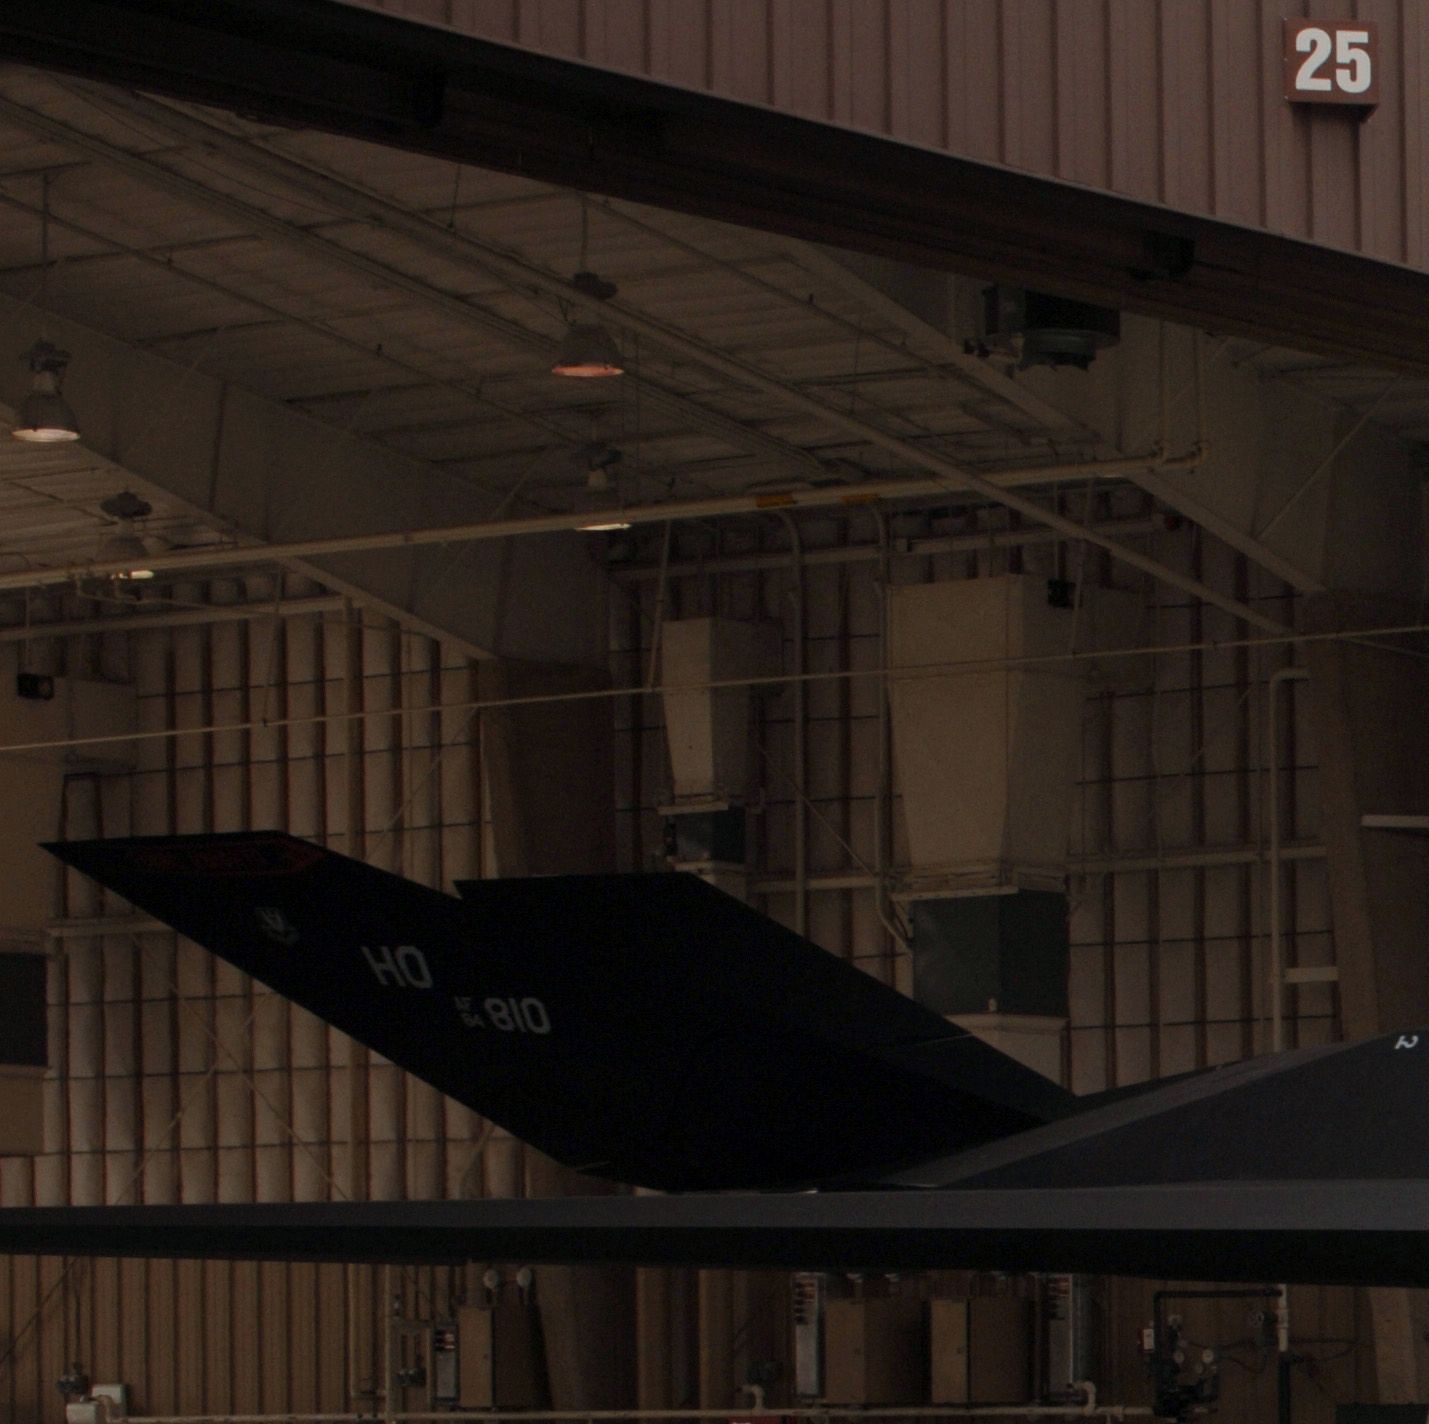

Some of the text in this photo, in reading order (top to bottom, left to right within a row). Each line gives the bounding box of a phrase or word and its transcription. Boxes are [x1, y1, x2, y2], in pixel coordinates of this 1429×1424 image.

[1295, 27, 1371, 93] 25
[361, 945, 433, 989] HO
[484, 997, 551, 1035] 810
